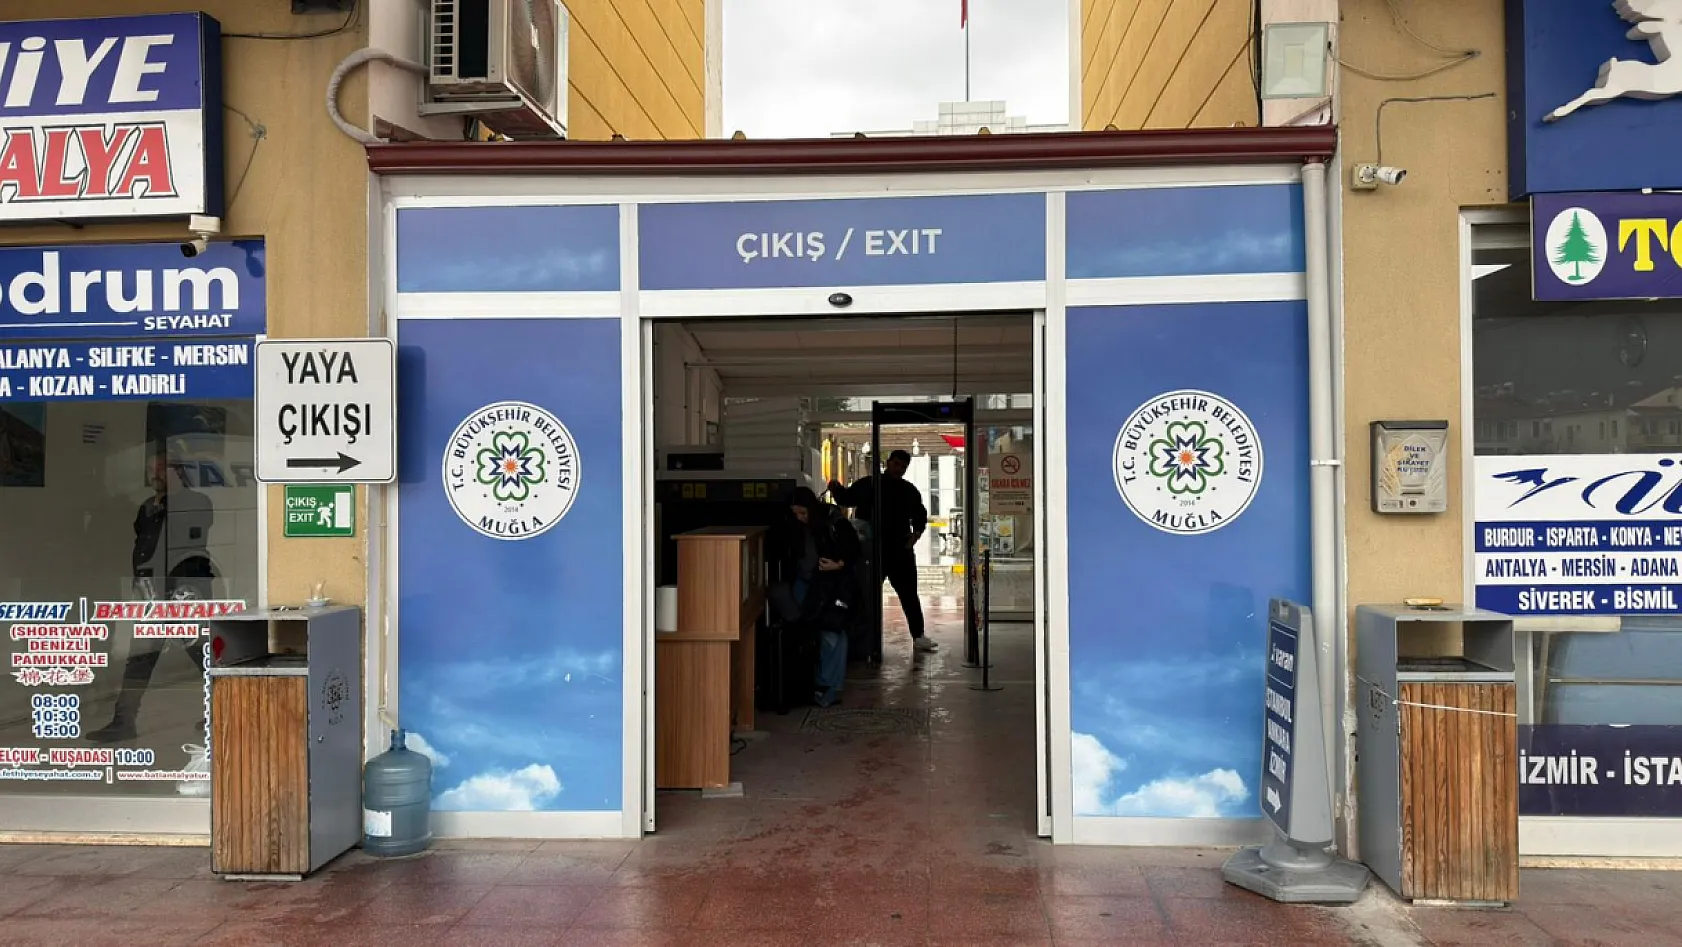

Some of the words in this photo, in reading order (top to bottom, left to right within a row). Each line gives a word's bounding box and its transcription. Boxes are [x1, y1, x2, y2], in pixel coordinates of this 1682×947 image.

[0, 34, 174, 107] İYE
[736, 231, 825, 264] ÇIKIŞ
[865, 228, 943, 255] EXIT
[1618, 218, 1682, 272] T
[0, 251, 239, 314] drum
[144, 314, 232, 330] SEYAHAT
[174, 344, 248, 367] MERSİN
[281, 352, 358, 384] YAYA
[30, 376, 94, 396] KOZAN
[278, 403, 371, 444] ÇIKIŞI
[453, 407, 531, 459] BÜYÜKŞEHİR
[1125, 396, 1208, 451] BÜYÜKŞEHİR
[534, 416, 572, 491] BELEDİYESİ
[1211, 405, 1253, 483] BELEDİYESİ
[452, 464, 464, 491] T.C.
[1122, 456, 1137, 485] T.C.
[287, 497, 317, 508] ÇIKIŞ
[289, 513, 314, 523] EXIT
[479, 516, 543, 534] MUĞLA
[1151, 508, 1222, 529] MUĞLA
[1484, 528, 1535, 547] BURDUR
[1547, 527, 1599, 546] ISPARTA
[1610, 527, 1652, 546] KONYA
[1664, 526, 1682, 545] NE
[1486, 559, 1547, 577] ANTALYA
[1562, 554, 1616, 577] MERSİN
[1631, 558, 1679, 576] ADANA
[1518, 588, 1595, 611] SİVEREK
[1614, 586, 1678, 610] BİSMİL
[0, 604, 70, 619] SEYAHAT
[95, 602, 146, 619] BATI
[12, 626, 107, 638] (SHORTWAY)
[135, 626, 198, 636] KALKAN
[30, 639, 89, 651] DENİZLİ
[13, 655, 107, 665] PAMUKKALE
[32, 696, 79, 708] 08:00
[34, 711, 79, 722] 10:30
[34, 725, 79, 736] 15:00
[51, 750, 112, 766] KUŞADASI
[117, 750, 154, 764] 10:00
[1519, 749, 1599, 785] İZMİR
